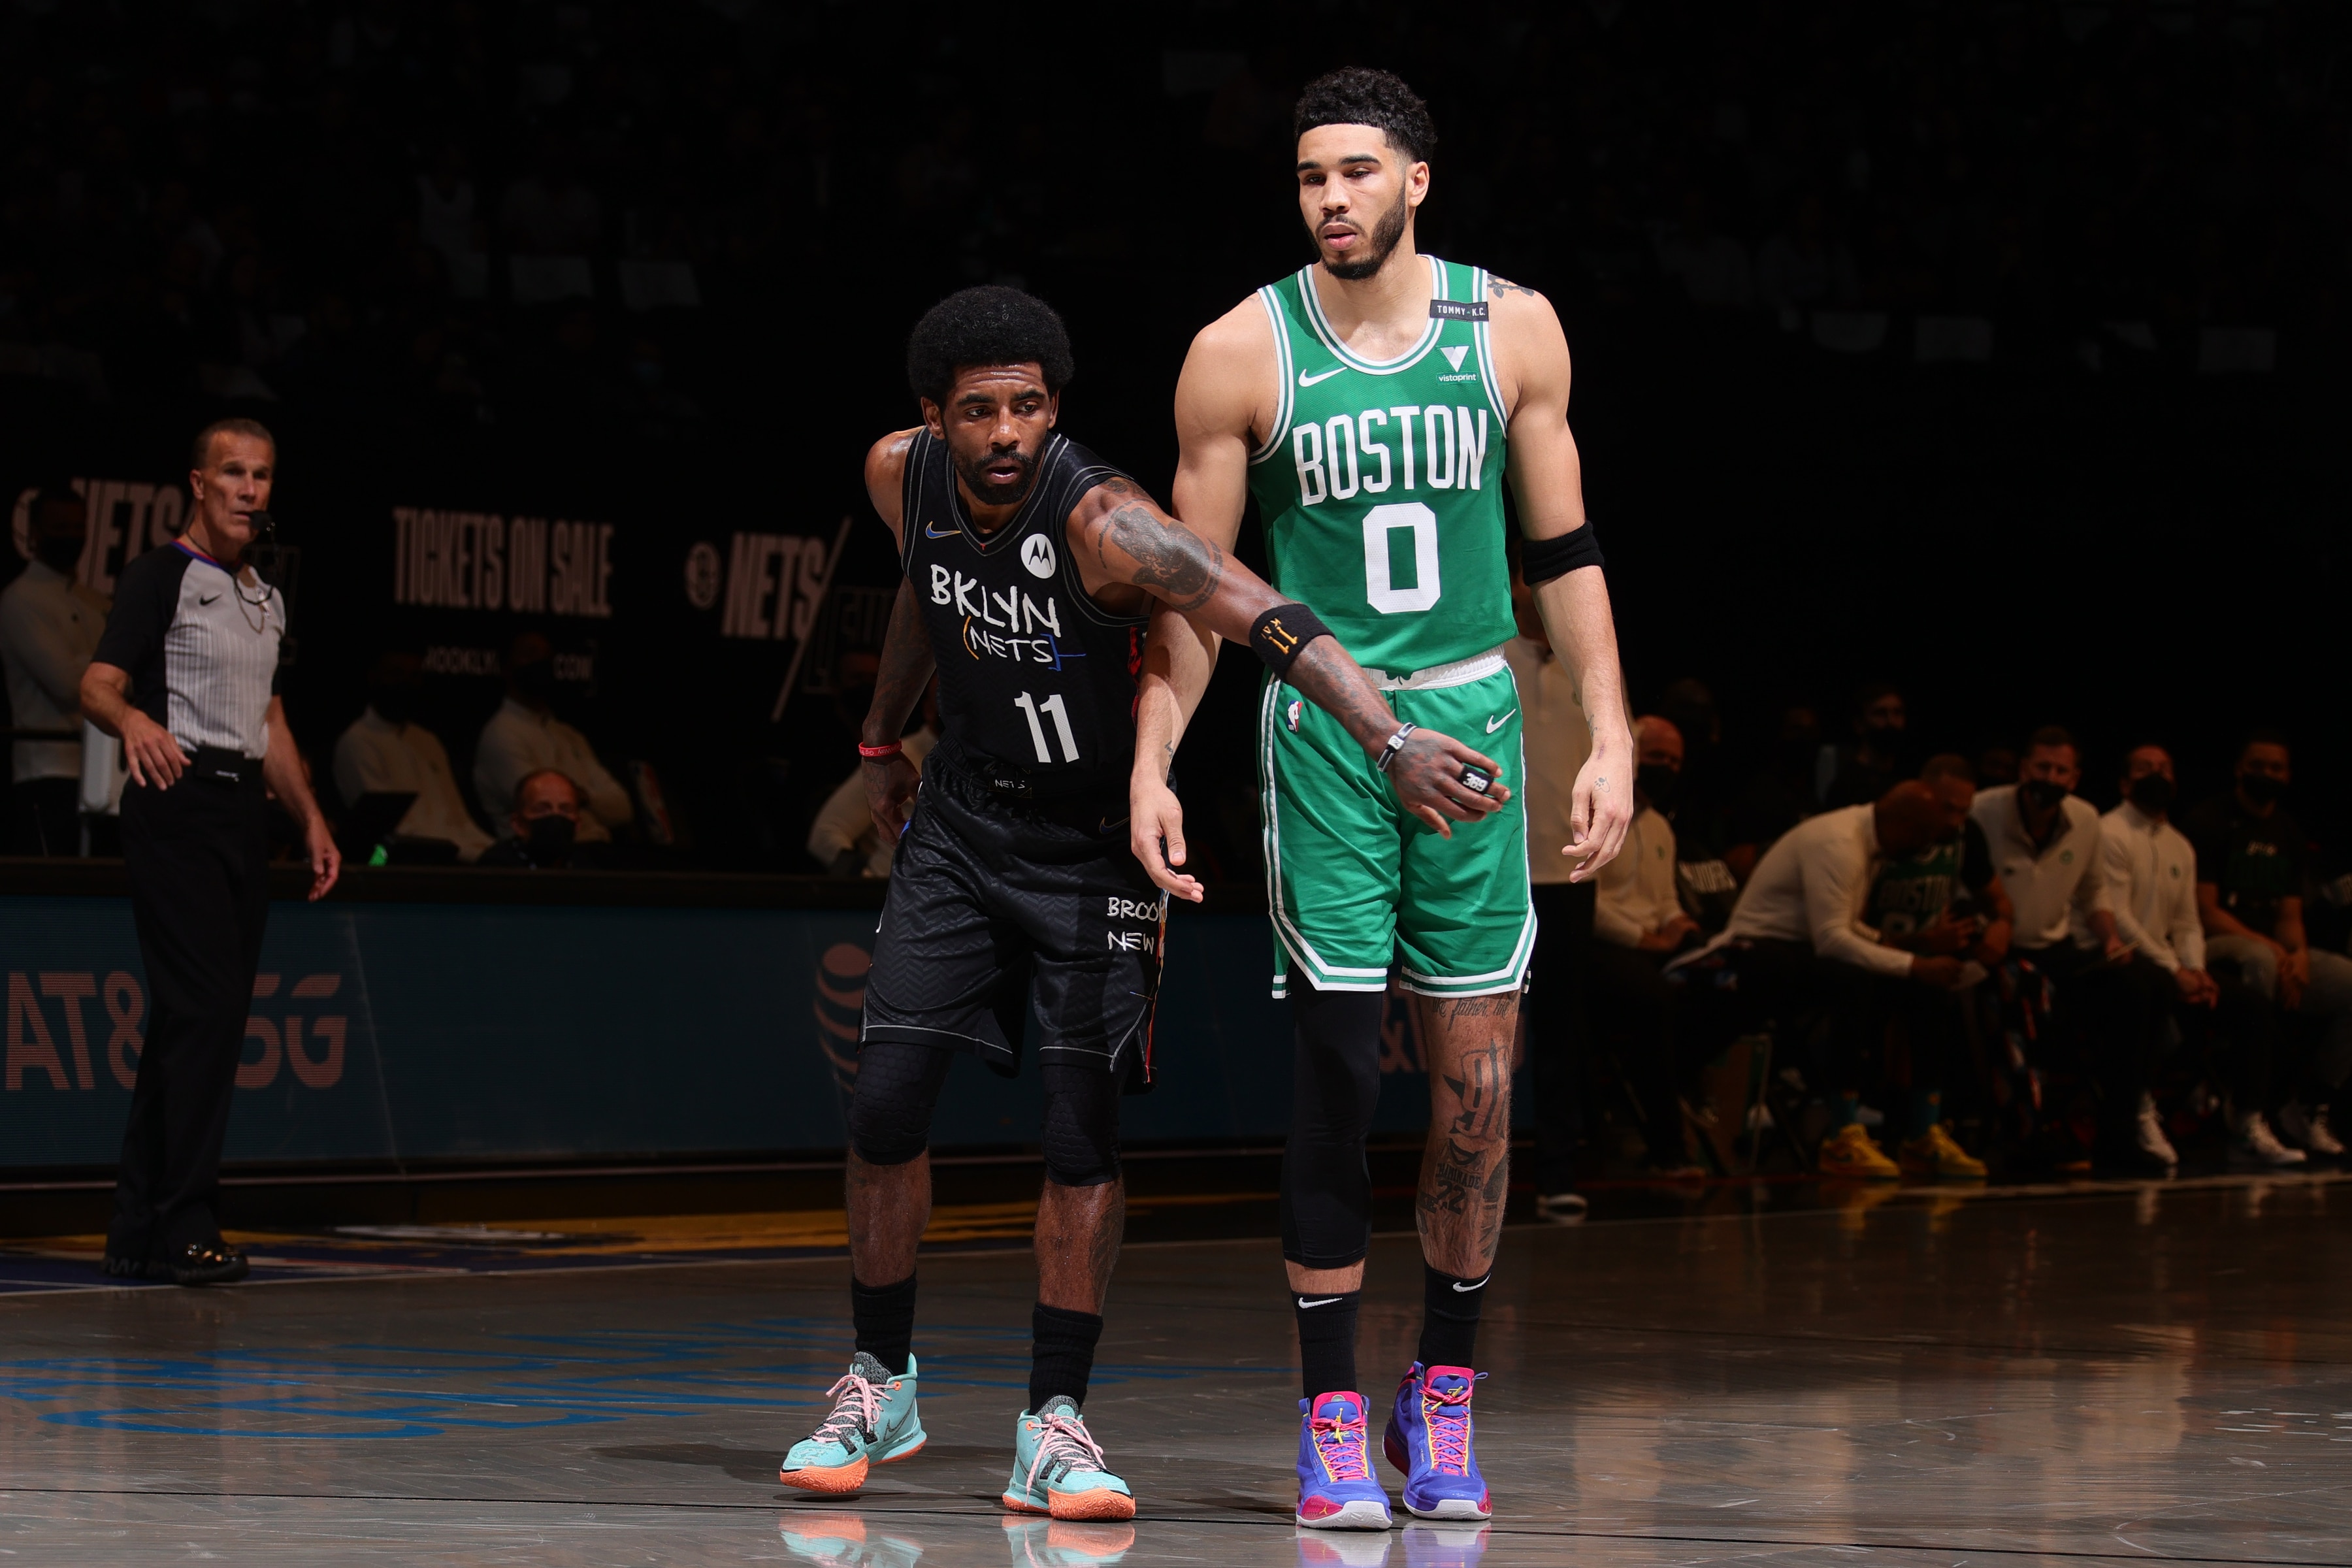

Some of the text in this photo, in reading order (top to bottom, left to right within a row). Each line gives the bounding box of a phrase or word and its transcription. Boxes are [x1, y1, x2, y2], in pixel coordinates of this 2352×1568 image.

[1437, 305, 1486, 316] TOMMY K.C.
[1438, 373, 1477, 382] vistaprint
[1292, 405, 1487, 506] BOSTON
[392, 506, 505, 612] TICKETS
[508, 514, 548, 615] ON
[550, 518, 615, 620] SALE
[719, 530, 828, 640] NETS
[1362, 502, 1441, 614] 0
[930, 564, 1061, 638] BKLYN
[1013, 691, 1080, 763] 11
[994, 778, 1026, 789] NETS
[1462, 772, 1488, 792] 369
[1107, 930, 1154, 955] NEW
[5, 971, 145, 1091] AT&
[1437, 1179, 1467, 1215] 22
